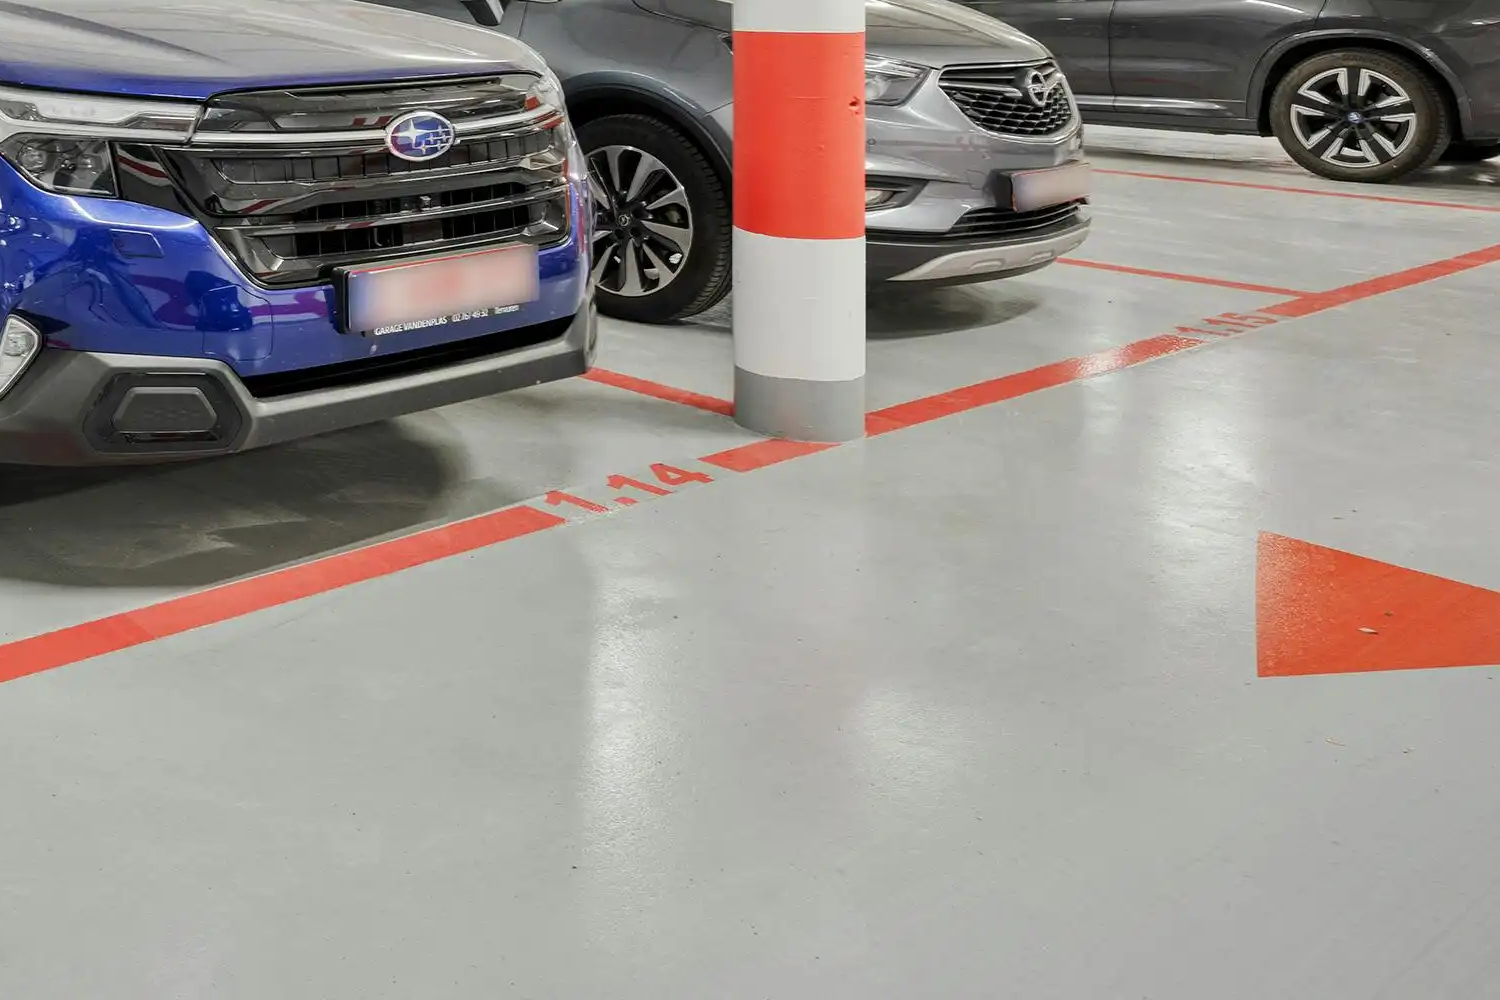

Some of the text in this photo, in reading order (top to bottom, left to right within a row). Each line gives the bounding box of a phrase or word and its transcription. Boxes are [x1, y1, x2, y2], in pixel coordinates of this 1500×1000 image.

[374, 325, 402, 336] GARAGE
[404, 316, 448, 331] VANDENPLAS
[1174, 312, 1278, 336] 1.15
[544, 463, 714, 513] 1.14
